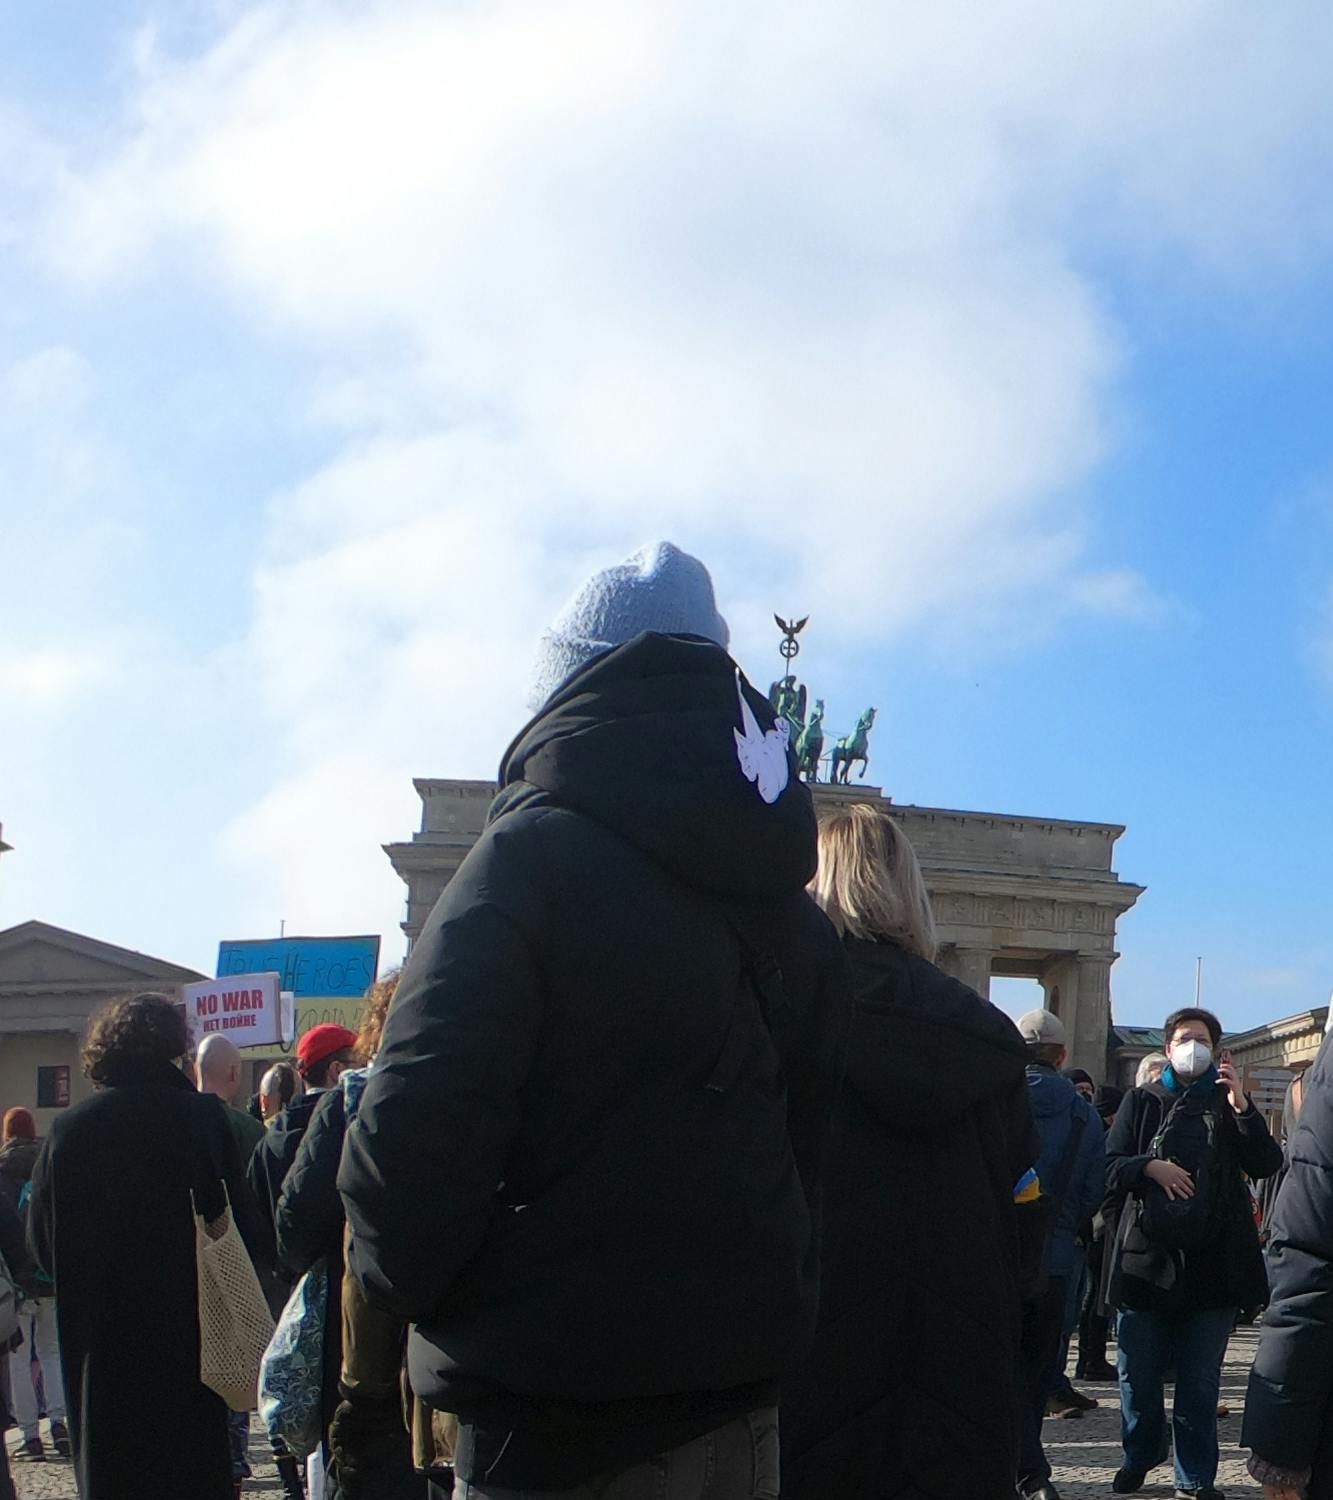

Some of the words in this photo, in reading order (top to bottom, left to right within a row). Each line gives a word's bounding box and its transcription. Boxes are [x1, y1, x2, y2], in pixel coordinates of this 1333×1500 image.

[282, 952, 374, 994] HEROES
[196, 994, 218, 1016] NO
[221, 989, 263, 1012] WAR
